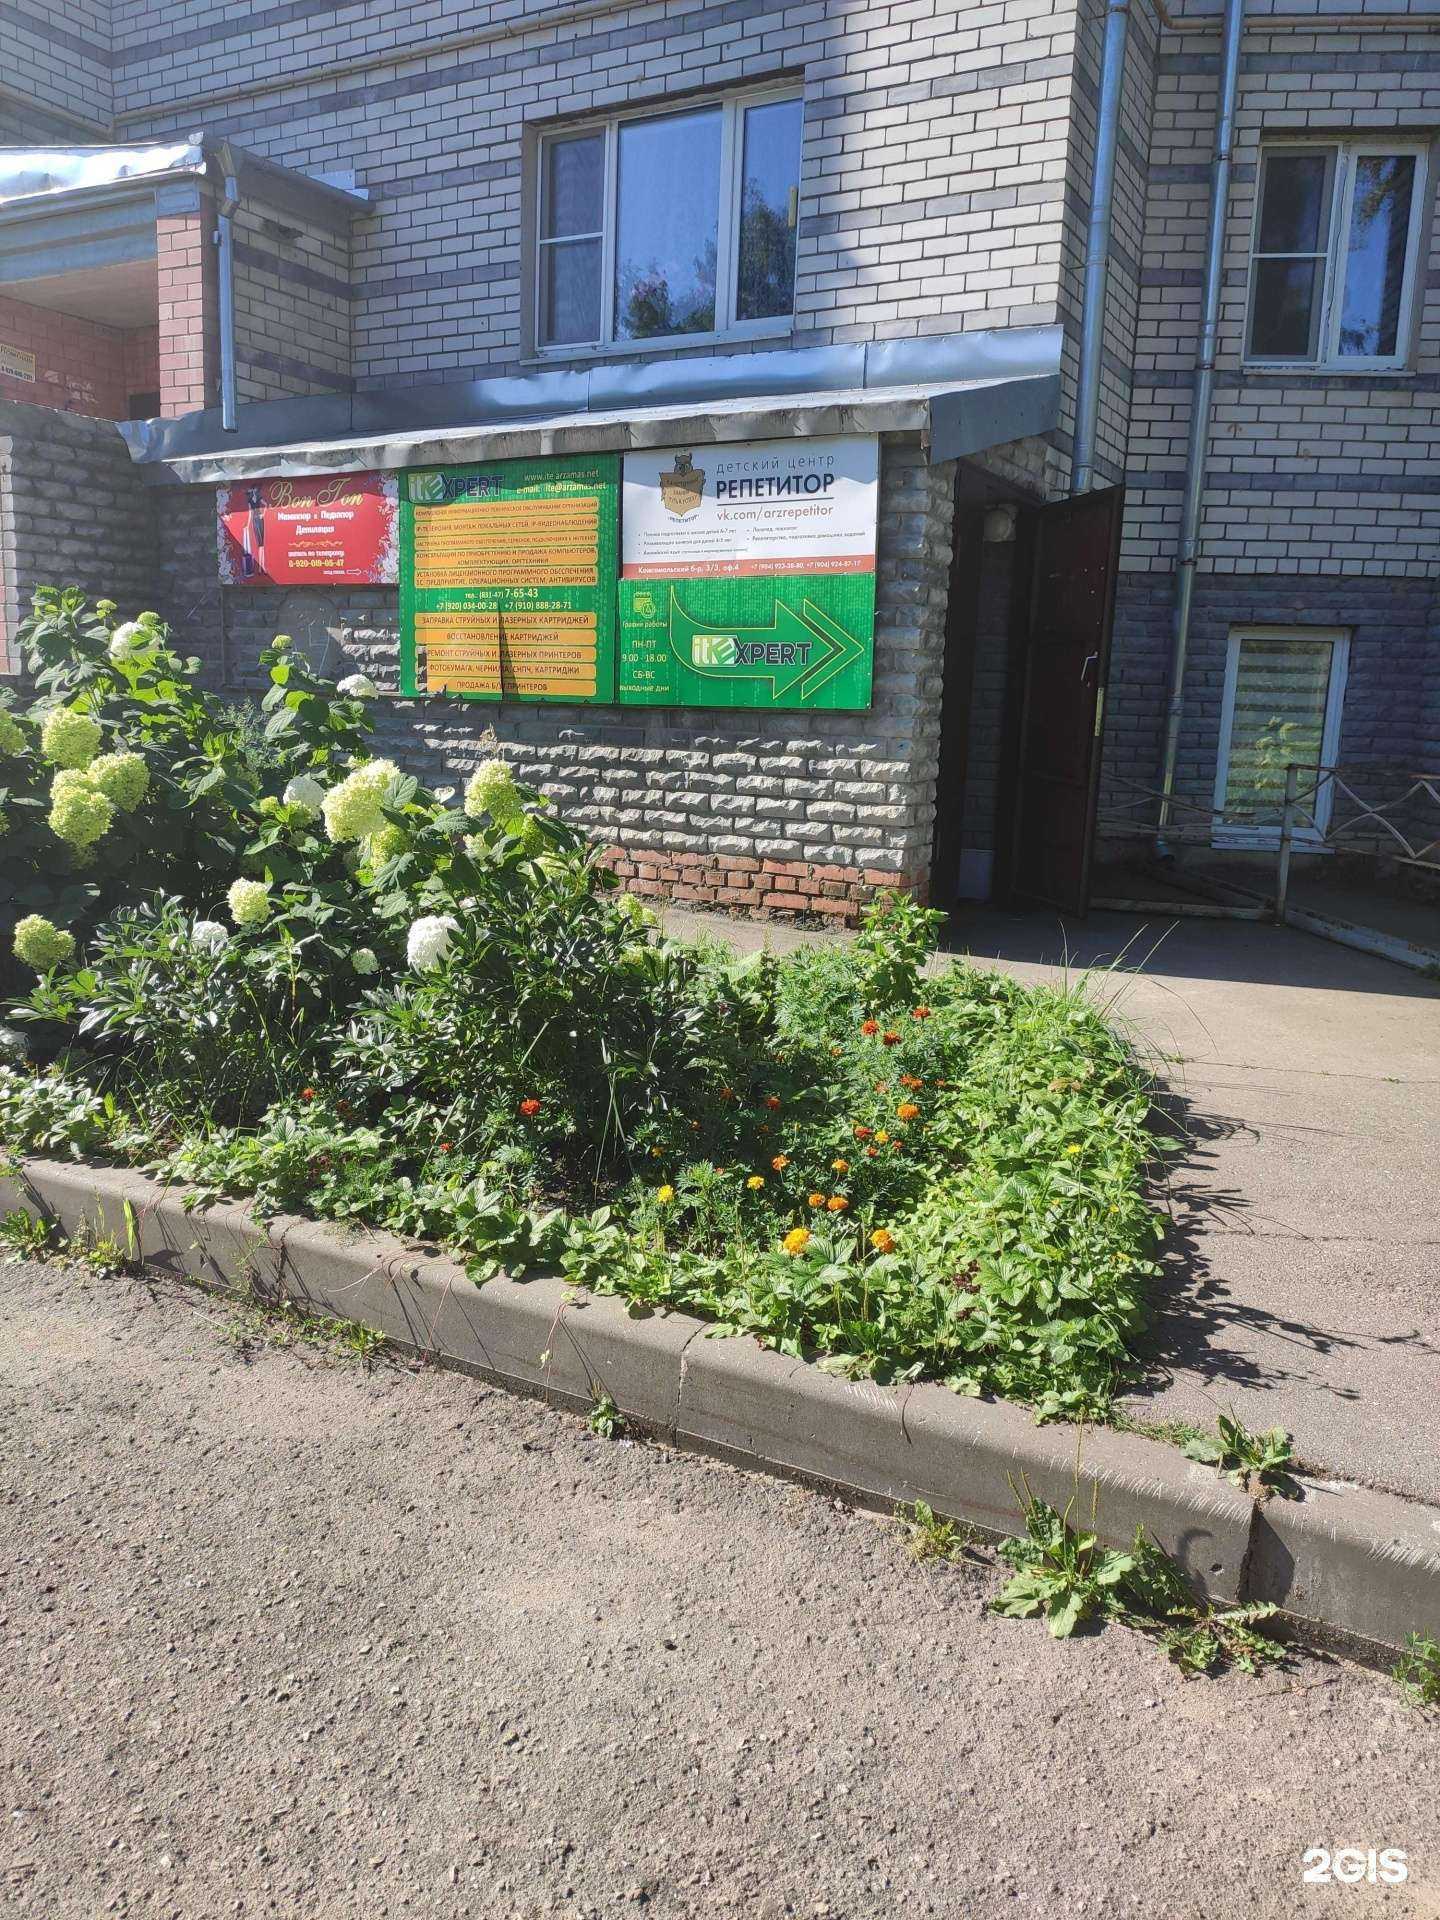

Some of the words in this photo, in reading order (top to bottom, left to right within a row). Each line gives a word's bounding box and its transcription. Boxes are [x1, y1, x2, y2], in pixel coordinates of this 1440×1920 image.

[716, 456, 779, 477] детский
[787, 455, 835, 471] центр
[716, 473, 835, 499] РЕПЕТИТОР
[269, 480, 313, 509] Bon
[317, 477, 364, 507] Ton
[717, 503, 834, 521] vk.com/arzrepetitor
[498, 568, 549, 576] ПРОГРАММНОГО
[468, 577, 519, 586] ОПЕРАЦИОННЫХ
[549, 575, 596, 584] АНТИВИРУСОВ
[505, 588, 539, 598] 7-65-43
[436, 602, 444, 610] +7
[445, 601, 462, 612] (920)
[463, 601, 498, 610] 034-00-28
[505, 602, 513, 610] +7
[515, 601, 534, 611] (910)
[535, 601, 572, 610] 888-28-71
[422, 616, 455, 624] ЗАПРАВКА
[455, 614, 491, 625] СТРУЙНЫХ
[492, 616, 498, 624] И
[499, 615, 538, 625] ЛАЗЕРНЫХ
[539, 614, 589, 626] КАРТРИДЖЕЙ
[510, 632, 560, 643] КАРТРИДЖЕЙ
[632, 639, 657, 649] ПН-ПТ
[427, 649, 454, 657] РЕМОНТ
[454, 647, 490, 657] СТРУЙНЫХ
[491, 649, 497, 657] И
[539, 651, 582, 659] ПРИНТЕРОВ
[534, 666, 580, 675] КАРТРИДЖИ
[632, 670, 656, 679] СБ-ВС
[456, 681, 490, 690] ПРОДАЖА
[507, 683, 549, 691] ПРИНТЕРОВ
[656, 684, 670, 693] дни
